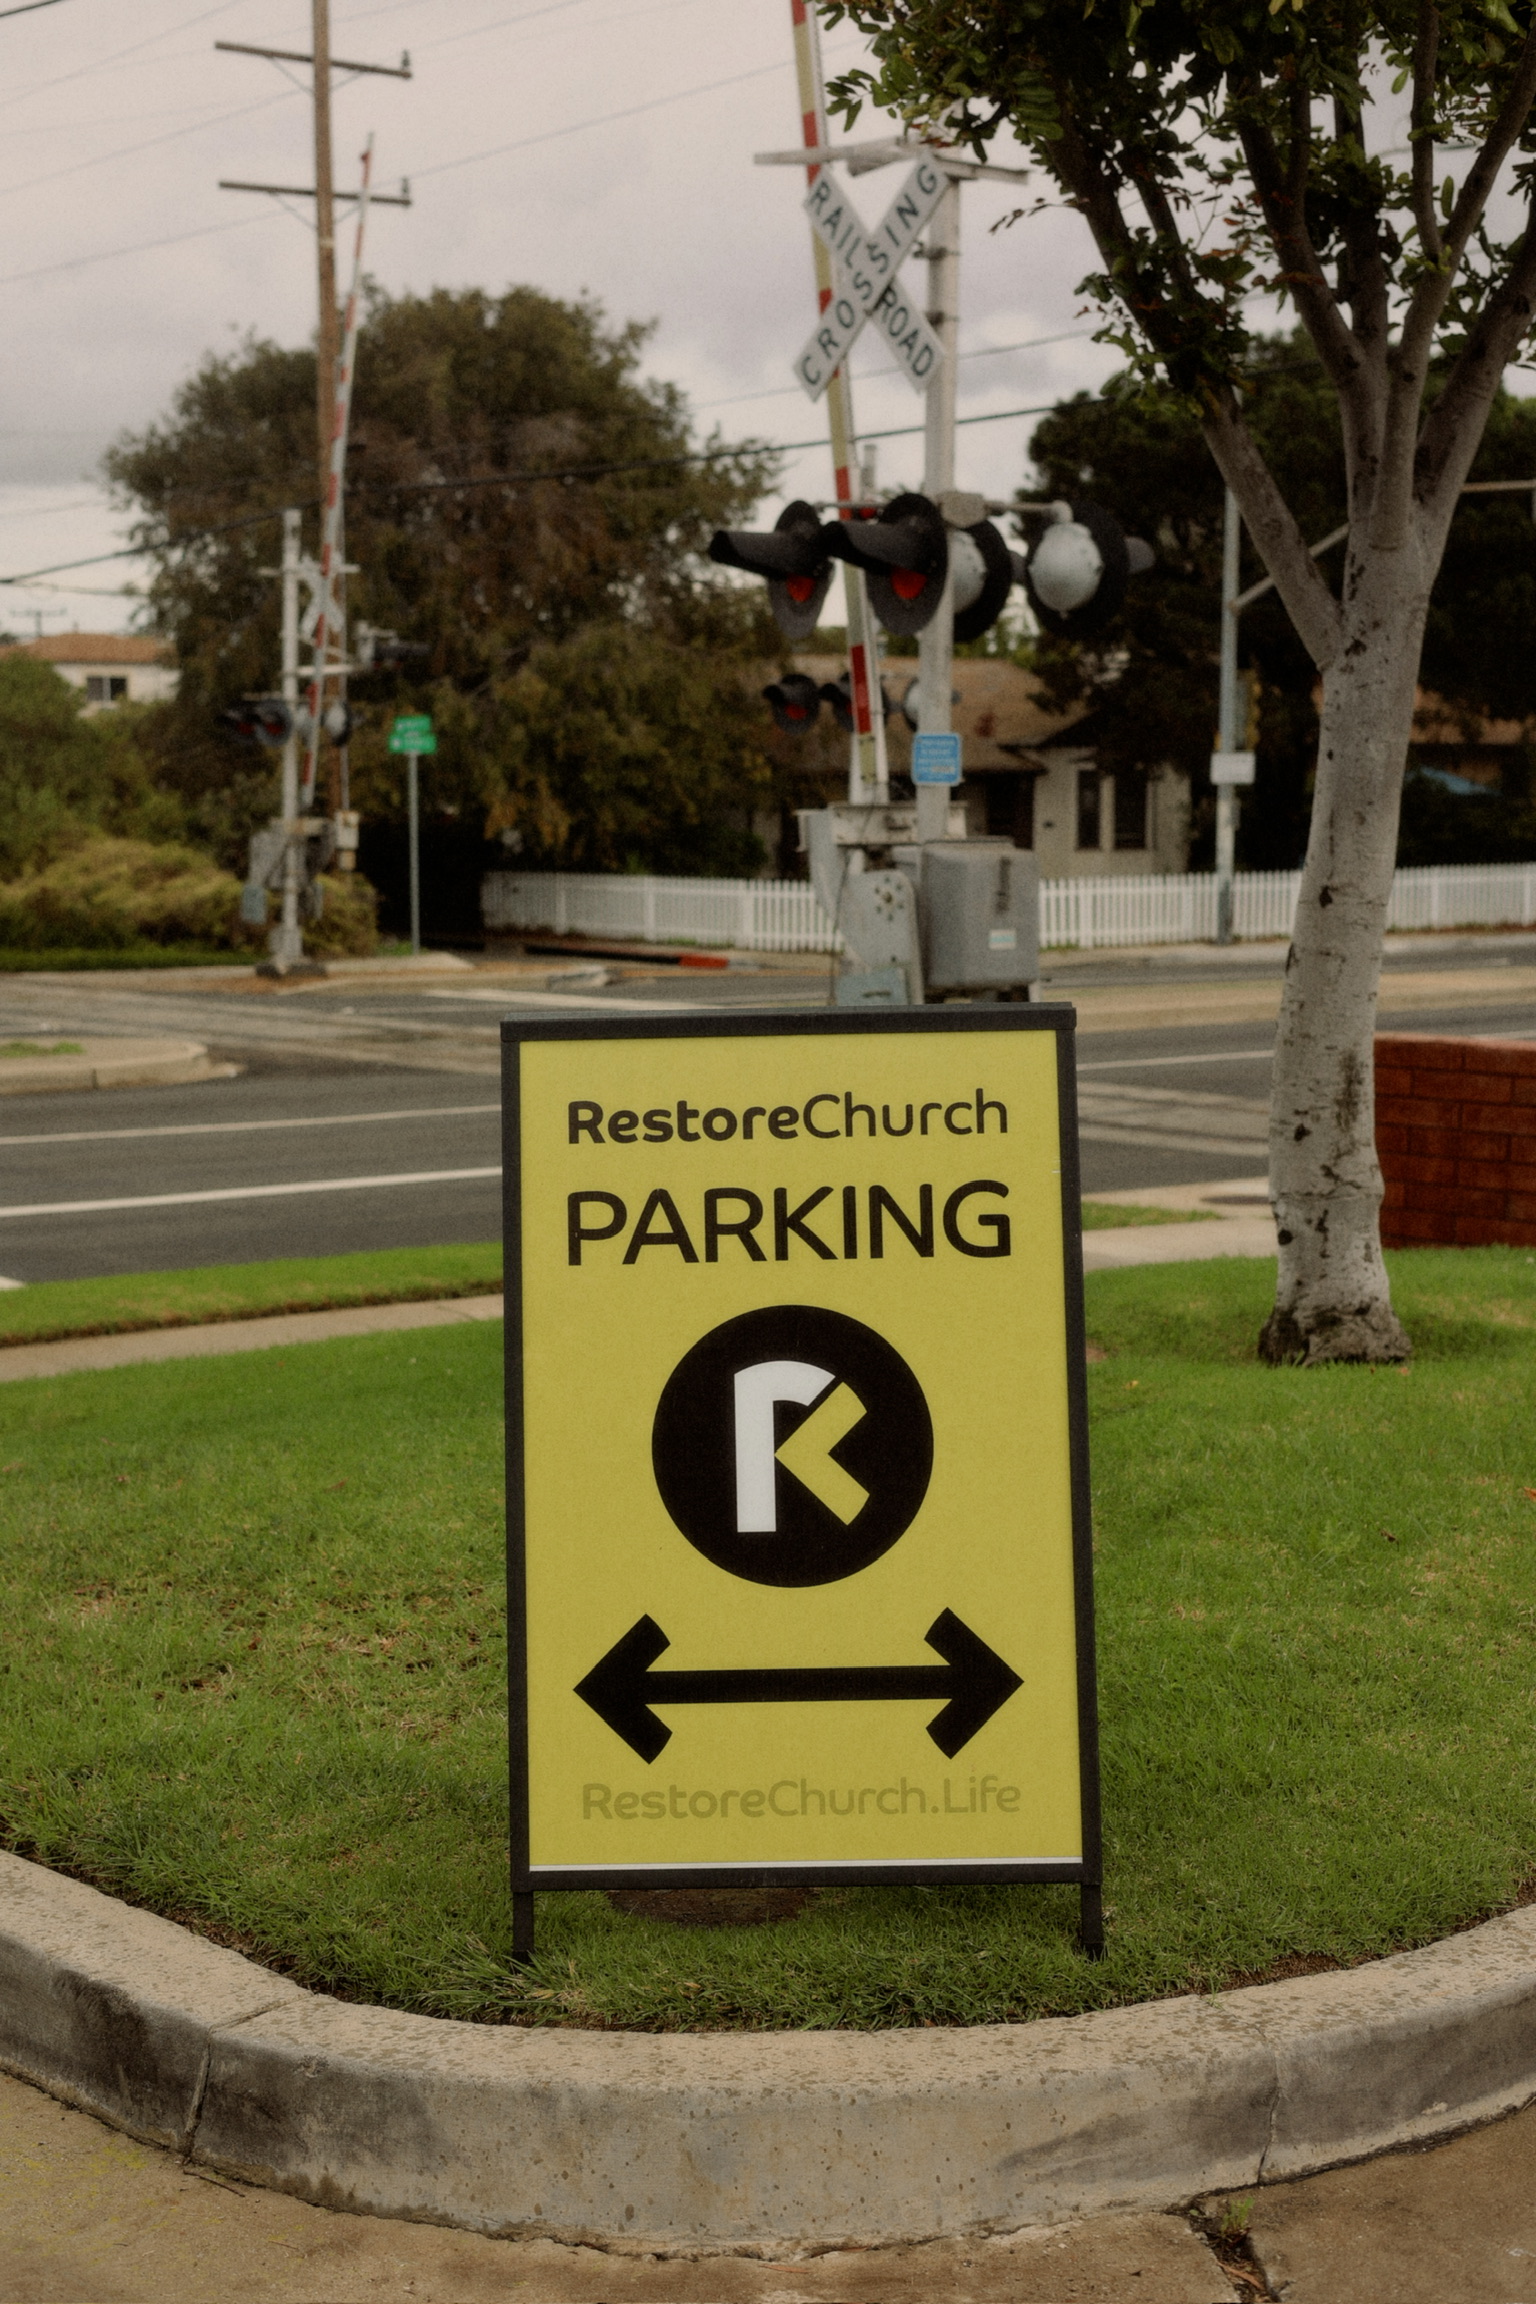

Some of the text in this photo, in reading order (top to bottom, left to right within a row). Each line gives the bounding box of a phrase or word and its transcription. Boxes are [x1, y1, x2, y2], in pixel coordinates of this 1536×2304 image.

[801, 164, 937, 385] CROSSING
[567, 1088, 1008, 1144] RestoreChurch
[567, 1179, 1012, 1266] PARKING
[582, 1776, 1021, 1819] RestoreChurch.Life
